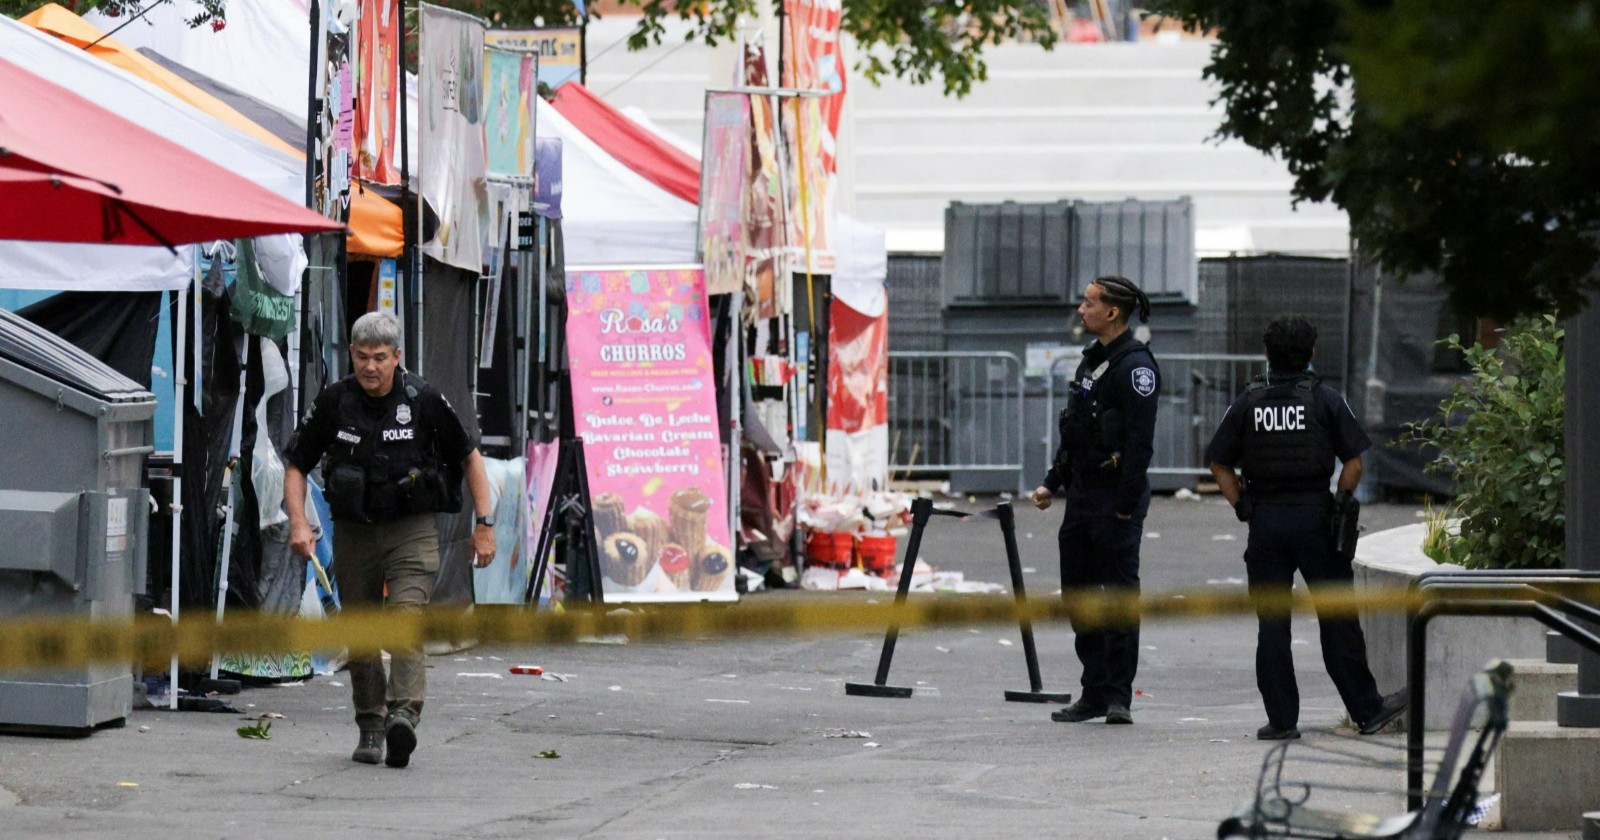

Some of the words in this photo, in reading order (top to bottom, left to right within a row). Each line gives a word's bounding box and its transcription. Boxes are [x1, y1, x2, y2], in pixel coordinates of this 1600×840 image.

[600, 343, 687, 363] CHURROS
[586, 414, 634, 428] Dulce
[639, 413, 663, 428] De
[668, 412, 711, 427] Leche
[1254, 405, 1306, 432] POLICE
[382, 429, 414, 442] POLICE
[581, 430, 655, 445] Bavarian
[661, 430, 713, 443] Cream
[613, 446, 690, 460] Chocolate
[606, 463, 699, 478] Strawberry
